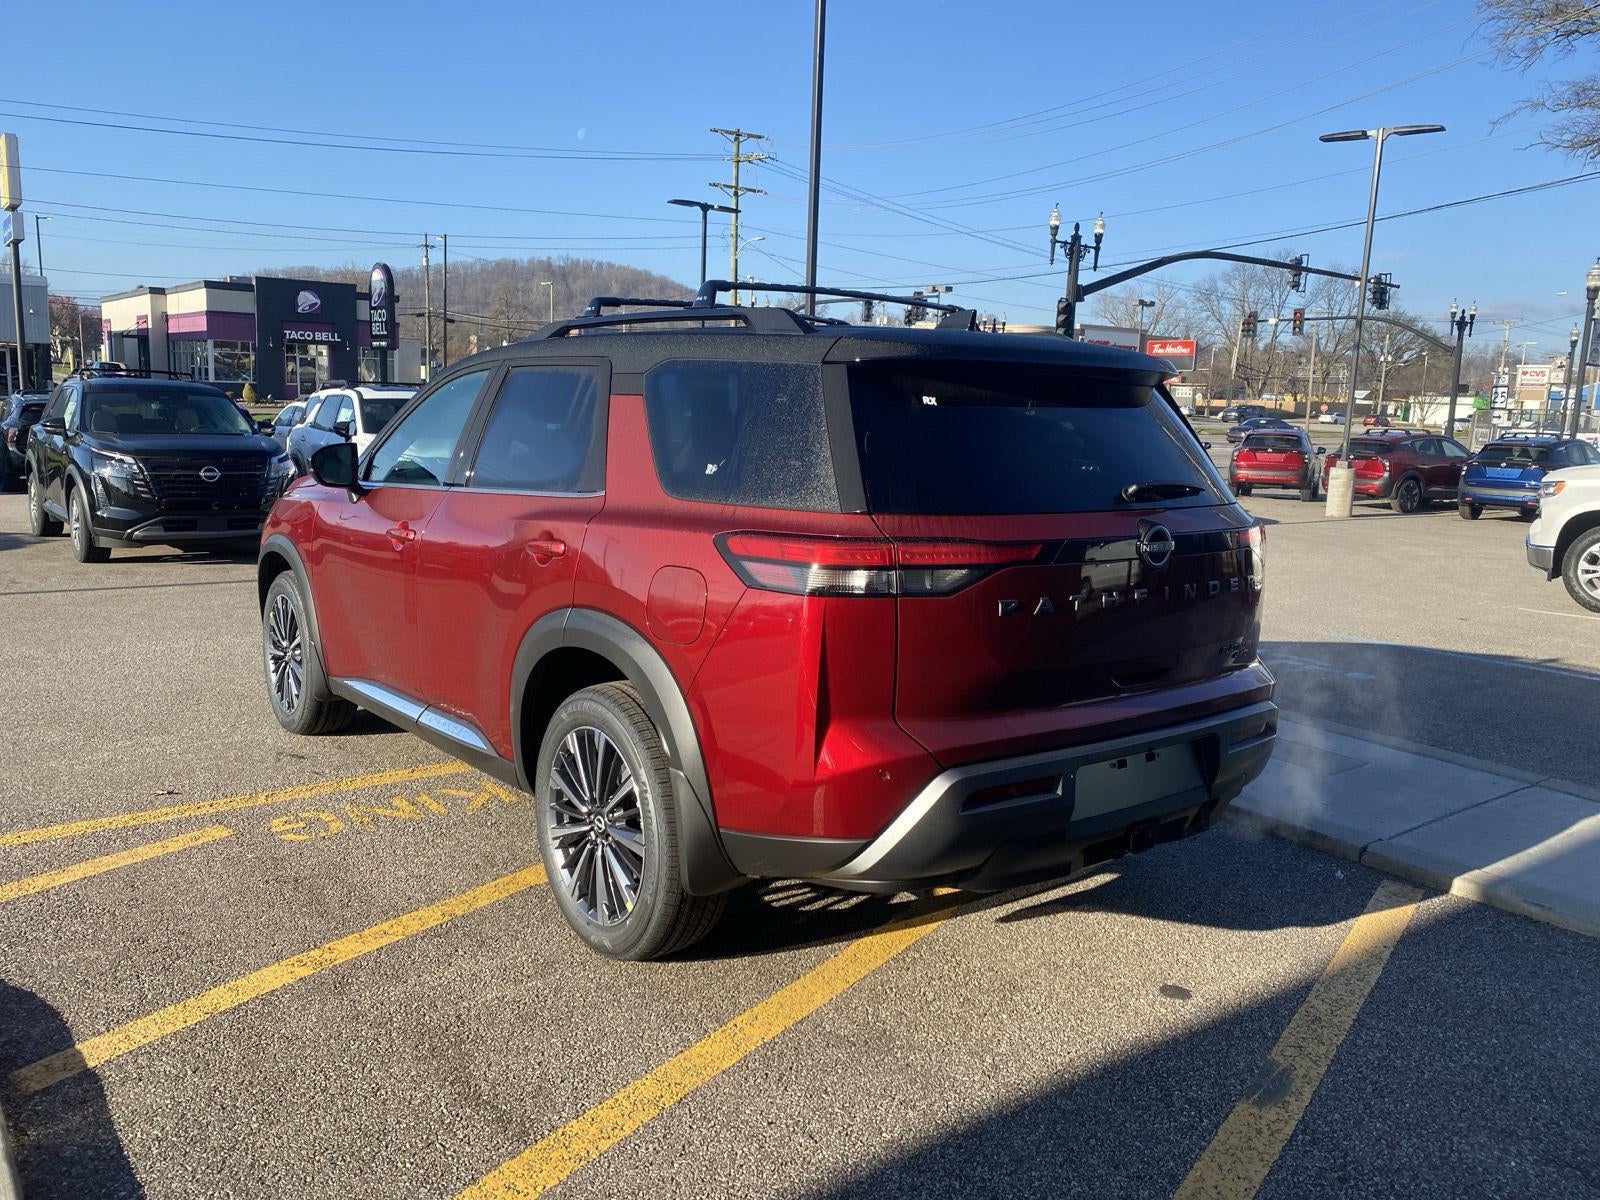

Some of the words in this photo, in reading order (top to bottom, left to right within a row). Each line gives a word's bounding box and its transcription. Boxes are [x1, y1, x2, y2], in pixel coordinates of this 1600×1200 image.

[371, 309, 386, 322] TACO
[372, 322, 387, 335] BELL
[284, 330, 313, 340] TACO
[315, 332, 341, 341] BELL
[1152, 344, 1165, 354] Tim
[1164, 343, 1190, 354] Hortons
[1529, 370, 1546, 378] CVS
[1492, 391, 1507, 404] 25
[998, 574, 1261, 617] PATHFINDER
